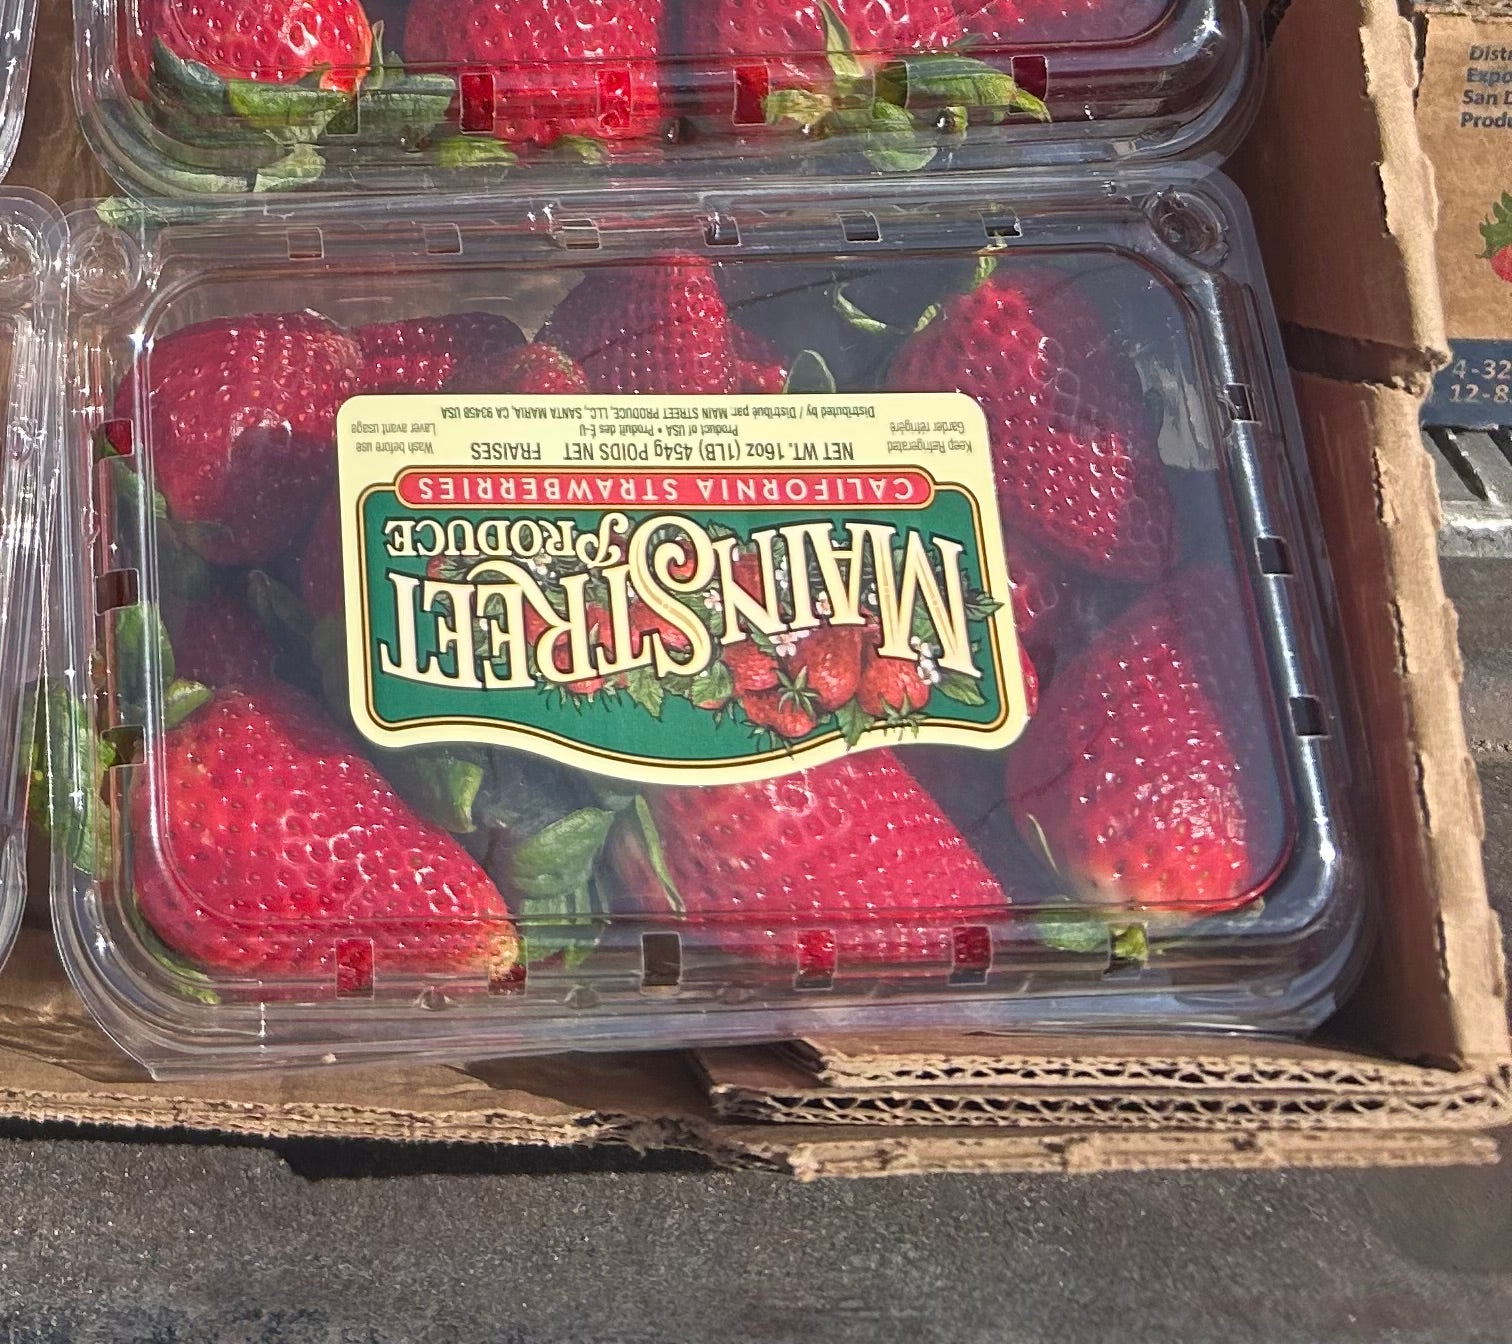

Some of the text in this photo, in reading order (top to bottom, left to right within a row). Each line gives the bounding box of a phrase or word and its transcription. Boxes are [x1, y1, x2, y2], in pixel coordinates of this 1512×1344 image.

[1463, 90, 1497, 105] San
[470, 440, 854, 461] NET WT. 16oz (1LB) 454g POIDS NET FRAISES
[419, 477, 913, 500] CALIFORNIA STRAWBERRIES
[385, 513, 628, 568] PRODUCE
